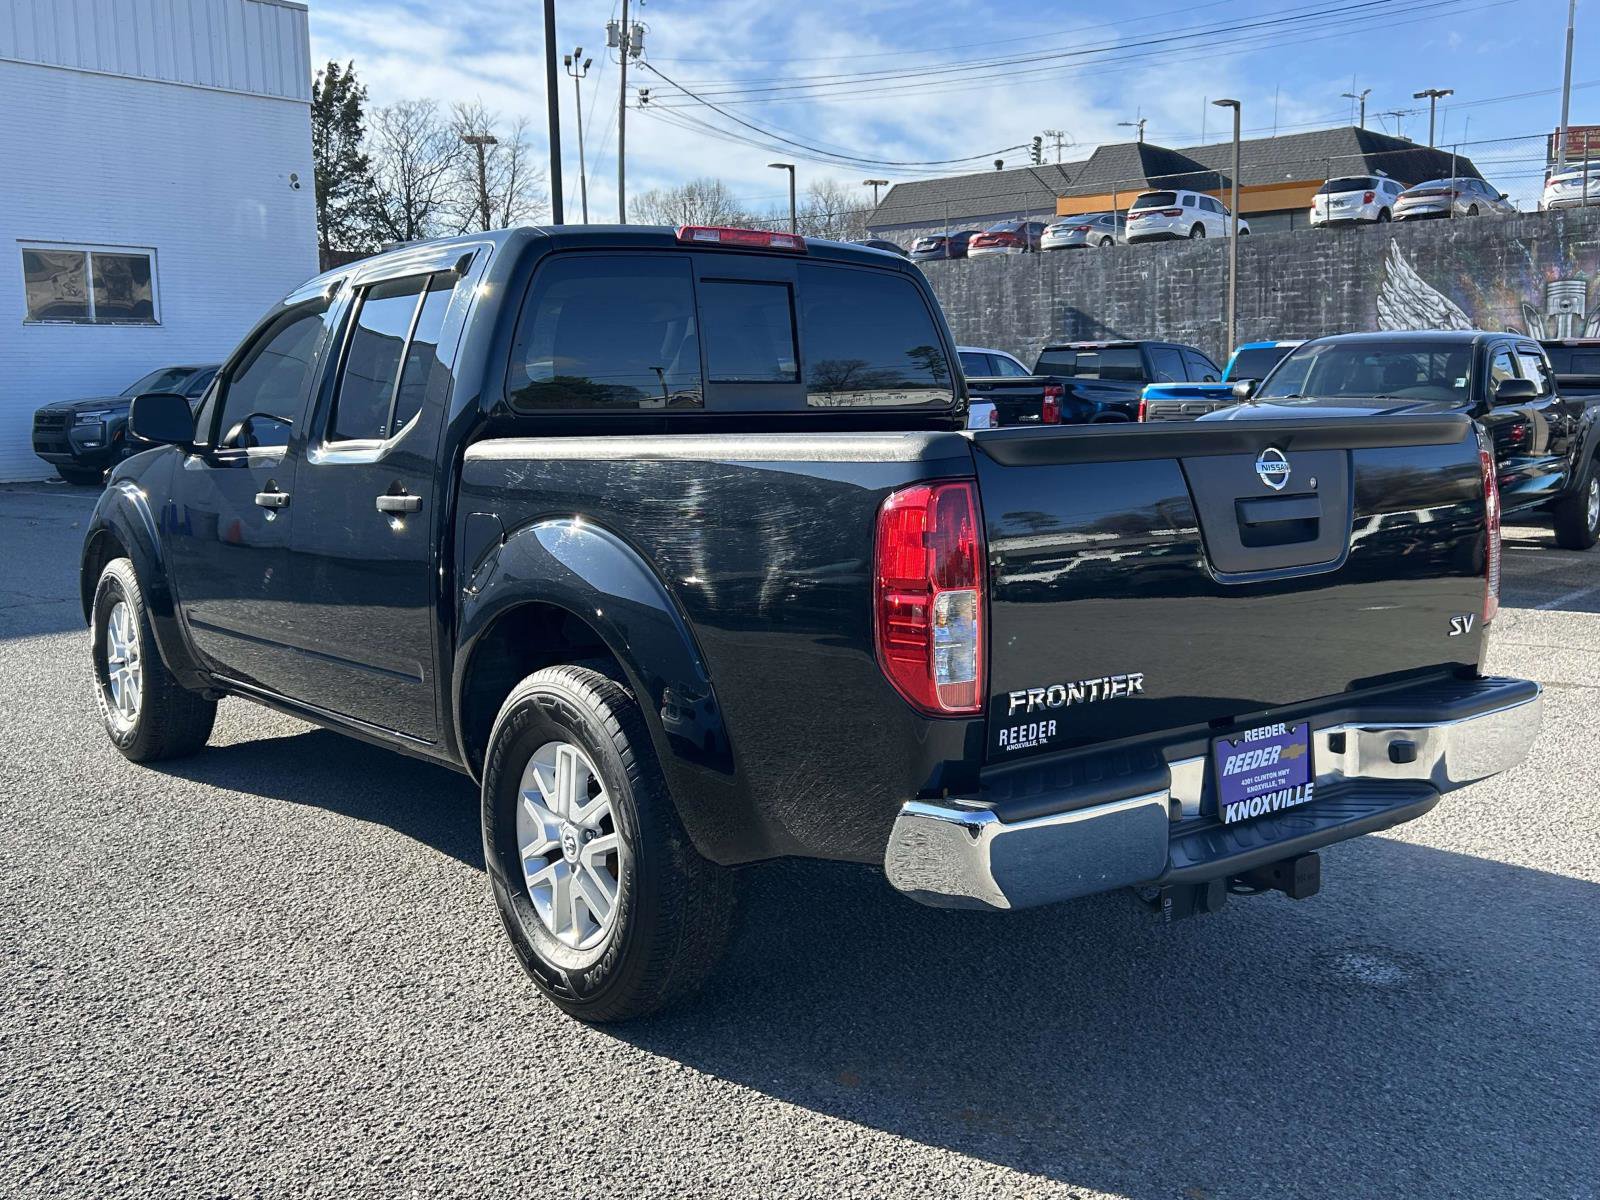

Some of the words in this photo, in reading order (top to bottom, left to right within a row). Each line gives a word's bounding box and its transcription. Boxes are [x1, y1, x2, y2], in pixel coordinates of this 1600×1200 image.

[1261, 463, 1288, 472] NISSAN
[1449, 613, 1474, 636] SV
[1008, 672, 1144, 716] FRONTIER
[999, 720, 1057, 746] REEDER
[1244, 723, 1287, 743] REEDER
[1006, 739, 1039, 751] KNOXVILLE,
[1223, 745, 1281, 776] REEDER
[1241, 777, 1254, 786] 4301
[1254, 772, 1277, 783] CLINTON
[1277, 768, 1290, 777] HWY
[1246, 780, 1278, 793] KNOXVILLE,
[1277, 778, 1286, 786] TN
[1225, 783, 1314, 824] KNOXVILLE
